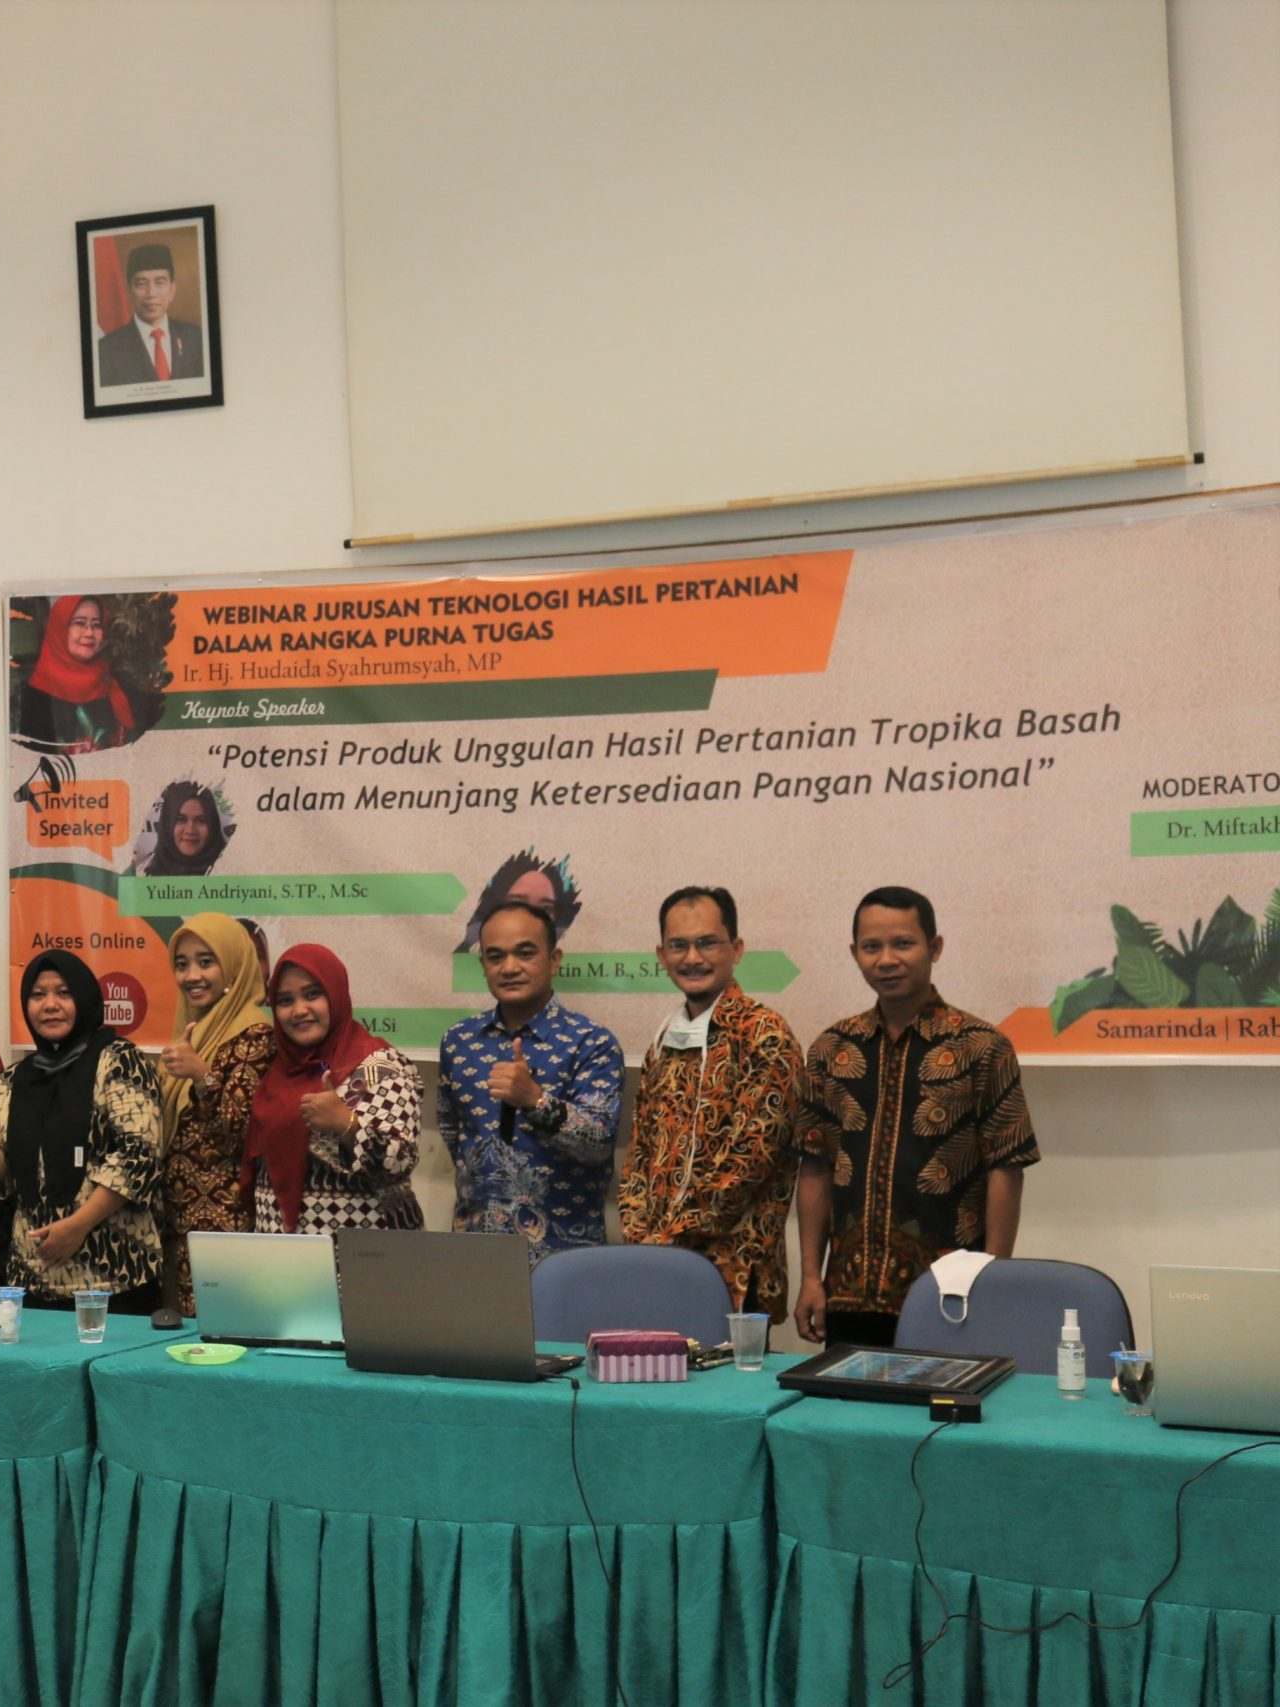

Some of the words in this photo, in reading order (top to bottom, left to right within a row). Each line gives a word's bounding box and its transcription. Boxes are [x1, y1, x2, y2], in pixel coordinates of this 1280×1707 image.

[203, 604, 308, 625] WEBINAR
[312, 599, 422, 622] JURUSAN
[428, 592, 569, 616] TEKNOLOGI
[578, 584, 649, 607] HASIL
[656, 573, 799, 602] PERTANIAN
[193, 634, 273, 655] DALAM
[280, 631, 378, 652] RANGKA
[384, 627, 465, 648] PURNA
[472, 620, 555, 643] TUGAS
[183, 663, 203, 682] Ir.
[208, 661, 234, 686] Hj.
[240, 660, 322, 681] Hudaida
[326, 656, 462, 682] Syahrumsyah,
[467, 652, 503, 673] MP
[181, 701, 250, 722] Keynote
[253, 697, 326, 721] Speaker
[339, 738, 442, 765] Produk
[454, 732, 595, 768] Unggulan
[604, 728, 683, 760] Hasil
[696, 718, 857, 755] Pertanian
[871, 712, 1003, 752] Tropika
[1017, 703, 1122, 738] Basah
[256, 786, 346, 812] dalam
[355, 782, 519, 815] Menunjang
[530, 773, 742, 806] Ketersediaan
[753, 769, 872, 804] Pangan
[1142, 773, 1280, 798] MODERATO
[43, 793, 109, 810] Invited
[39, 821, 114, 838] Speaker
[1167, 821, 1198, 839] Dr.
[146, 885, 193, 900] Yulian
[198, 883, 277, 904] Andriyani,
[330, 883, 368, 899] M.Sc
[32, 934, 84, 950] Akses
[90, 933, 145, 950] Online
[553, 962, 582, 978] tin
[587, 962, 608, 977] M.
[107, 982, 128, 999] You
[104, 1004, 132, 1020] Tube
[1097, 1017, 1216, 1038] Samarinda
